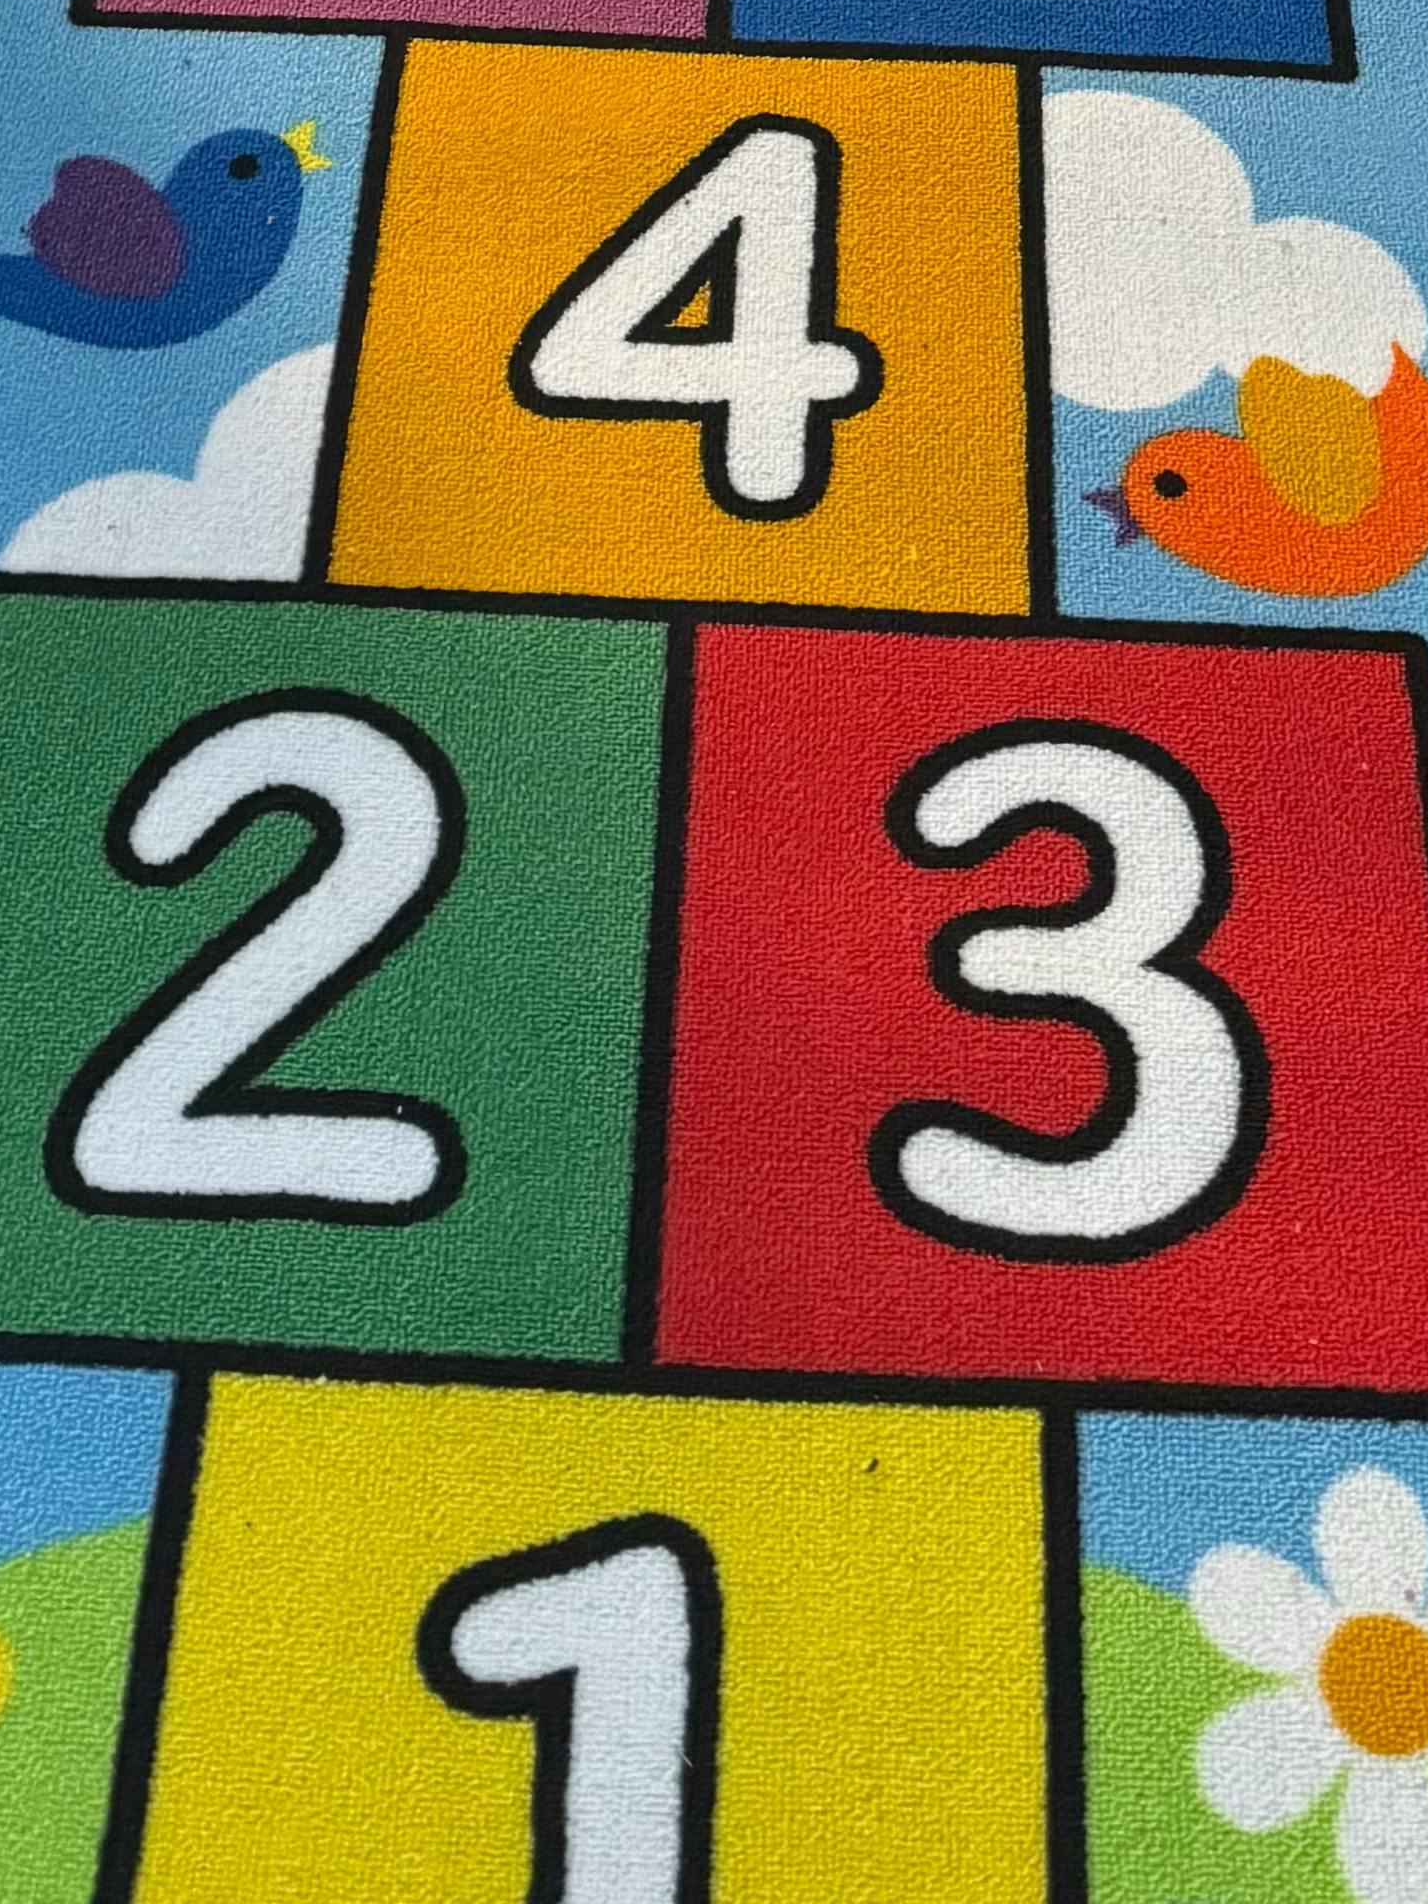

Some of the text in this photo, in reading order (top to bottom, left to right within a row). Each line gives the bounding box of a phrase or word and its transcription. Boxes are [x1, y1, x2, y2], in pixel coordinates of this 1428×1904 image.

[520, 121, 872, 514] 4
[60, 702, 454, 1218] 2
[886, 732, 1256, 1252] 3
[434, 1532, 705, 1904] 1
